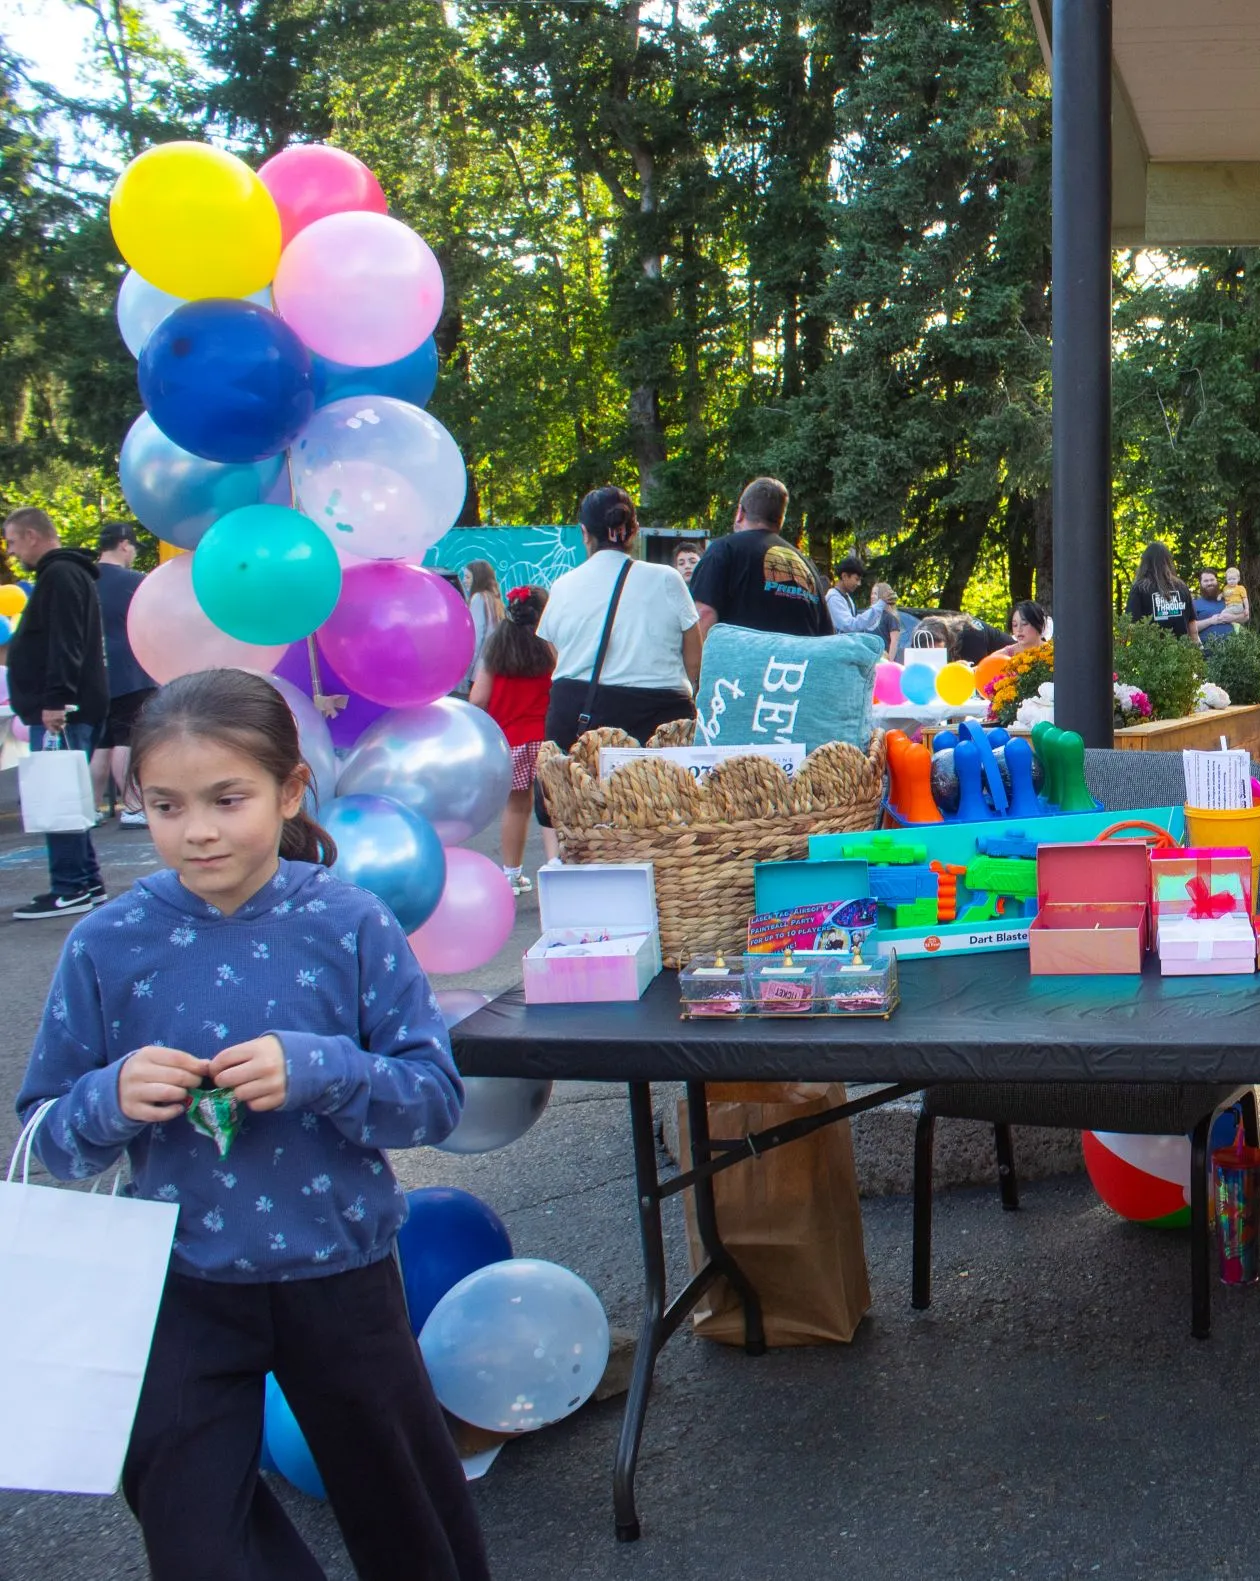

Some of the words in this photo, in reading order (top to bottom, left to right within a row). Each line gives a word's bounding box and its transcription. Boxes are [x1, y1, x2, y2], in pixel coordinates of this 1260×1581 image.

[1155, 595, 1178, 605] BRK
[751, 914, 773, 924] LASER
[793, 905, 824, 915] AIRSOFT
[750, 923, 788, 935] PAINTBALL
[791, 917, 815, 926] PARTY
[750, 938, 764, 946] FOR
[797, 926, 832, 935] PLAYERS
[970, 935, 993, 945] Dart
[996, 932, 1028, 943] Blaste
[775, 988, 797, 999] TICKET
